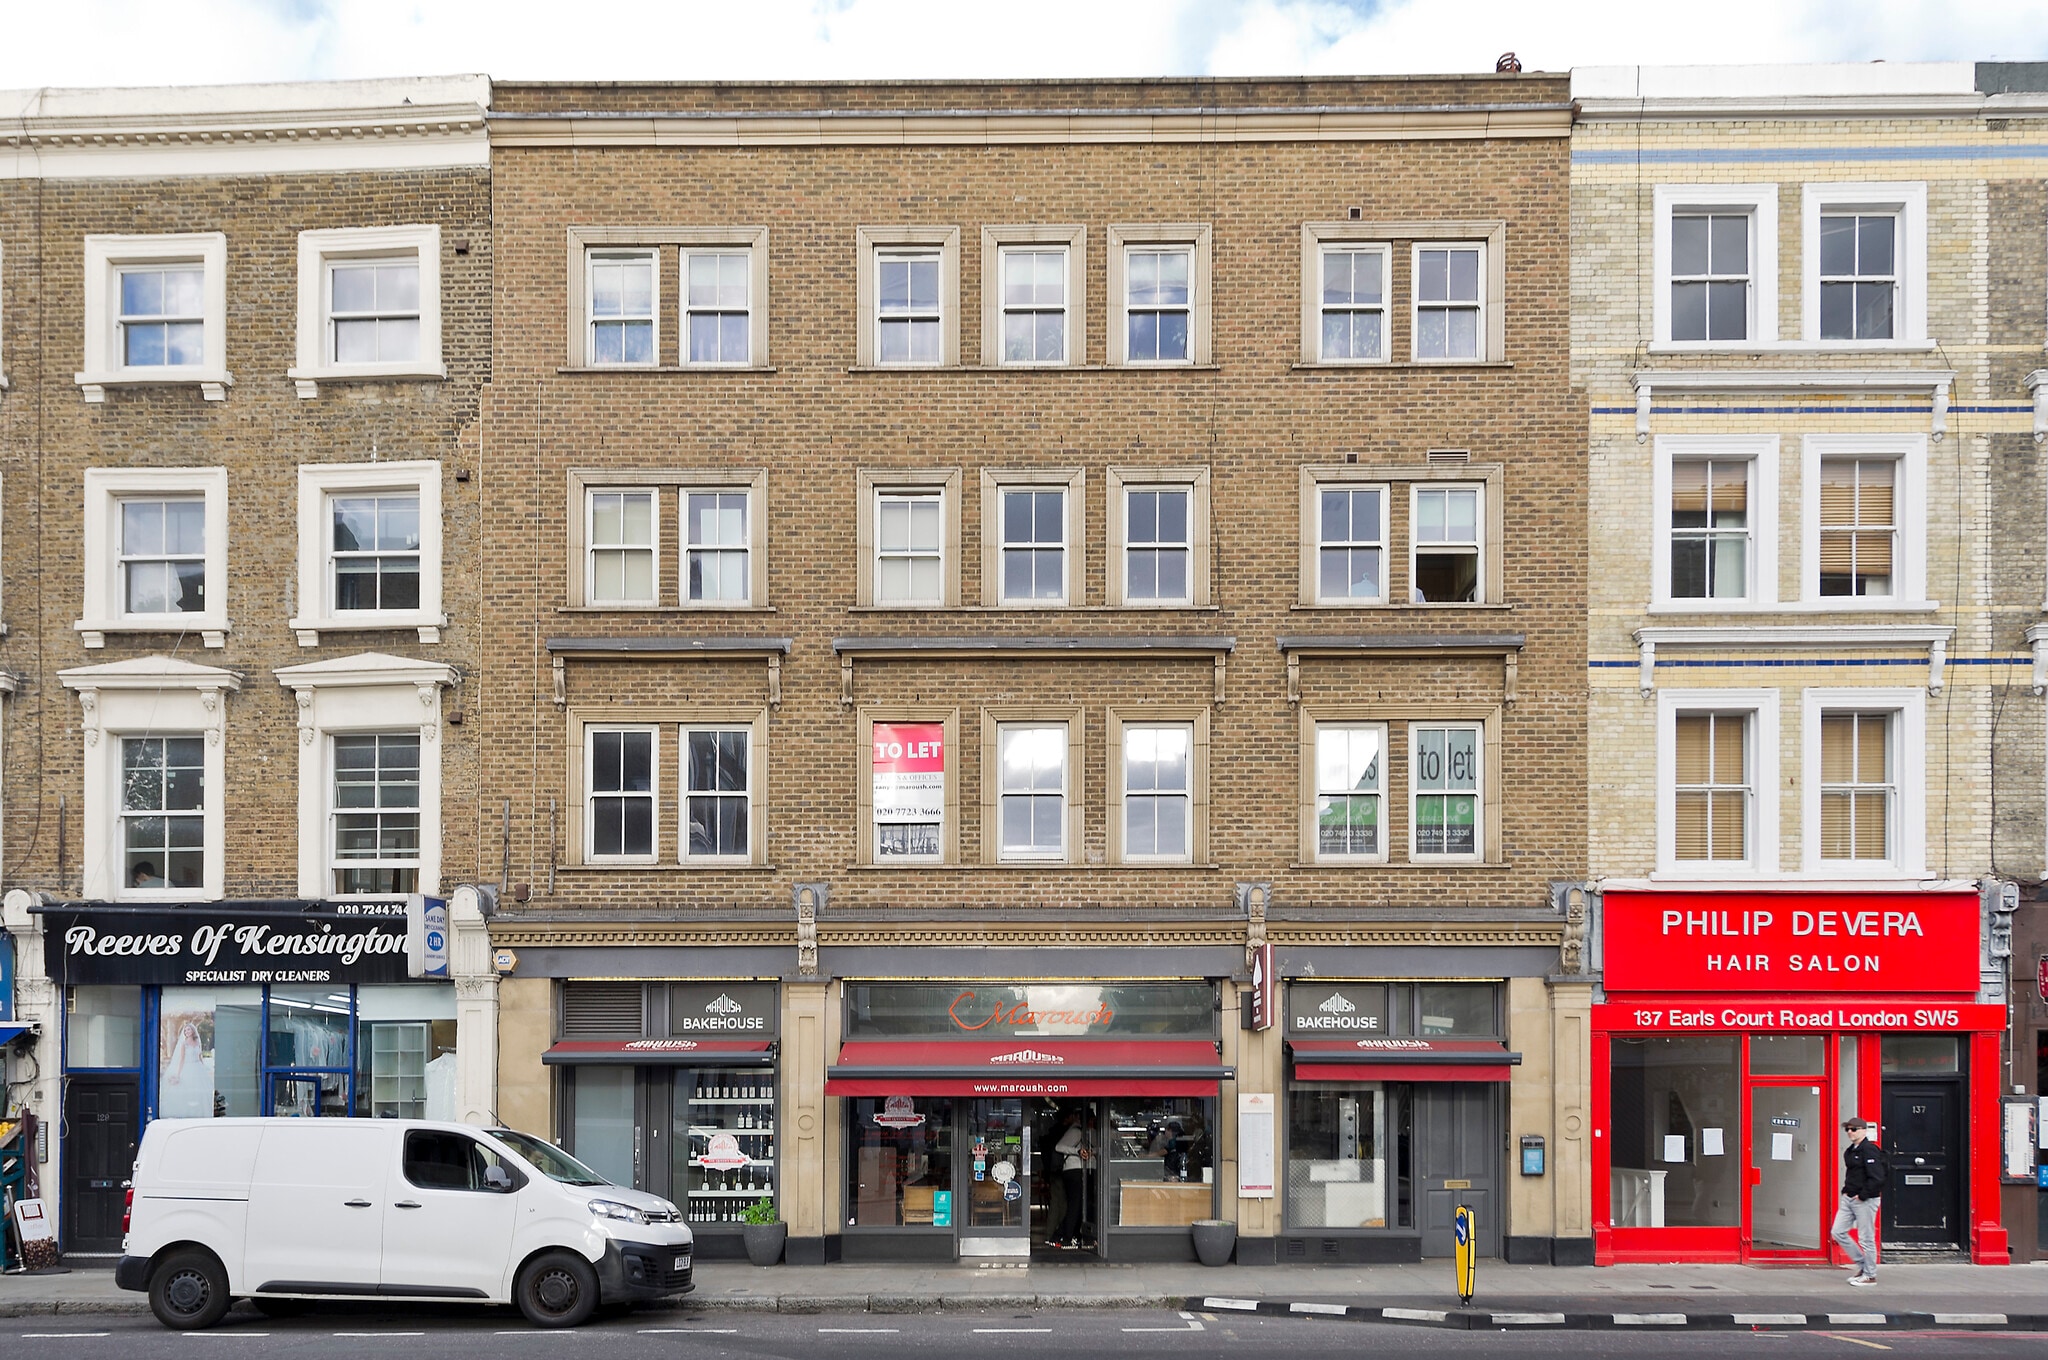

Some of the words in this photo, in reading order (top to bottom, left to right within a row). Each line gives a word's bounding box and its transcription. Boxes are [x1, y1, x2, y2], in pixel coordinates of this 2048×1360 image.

[876, 742, 902, 758] TO
[908, 742, 941, 758] LET
[1418, 744, 1440, 780] to
[1448, 742, 1474, 780] let
[876, 808, 893, 816] 020
[896, 808, 918, 816] 7723
[920, 808, 941, 816] 3666
[338, 905, 359, 914] 020
[362, 905, 389, 914] 7244
[1662, 910, 1774, 936] PHILIP
[1792, 911, 1924, 937] DEVERA
[65, 925, 183, 956] Reeves
[190, 923, 235, 967] Of
[234, 924, 409, 966] Kensington
[429, 936, 433, 946] 2
[433, 936, 442, 947] HR
[1707, 954, 1770, 972] HAIR
[1789, 954, 1880, 972] SALON
[185, 970, 247, 982] SPECIALIST
[251, 970, 274, 983] DRY
[275, 970, 330, 982] CLEANERS
[705, 992, 742, 1016] MAROUSH
[949, 991, 1113, 1031] Maroush
[1319, 992, 1356, 1016] MAROUSH
[683, 1018, 764, 1030] BAKEHOUSE
[1296, 1016, 1378, 1028] BAKEHOUSE
[1633, 1010, 1662, 1026] 137
[1669, 1010, 1715, 1026] Earls
[1721, 1010, 1774, 1026] Court
[1780, 1010, 1833, 1026] Road
[1838, 1010, 1908, 1026] London
[1913, 1010, 1959, 1026] SW5
[990, 1050, 1064, 1064] MAROUSH
[974, 1084, 1068, 1092] www.maroush.com
[1912, 1106, 1926, 1114] 137
